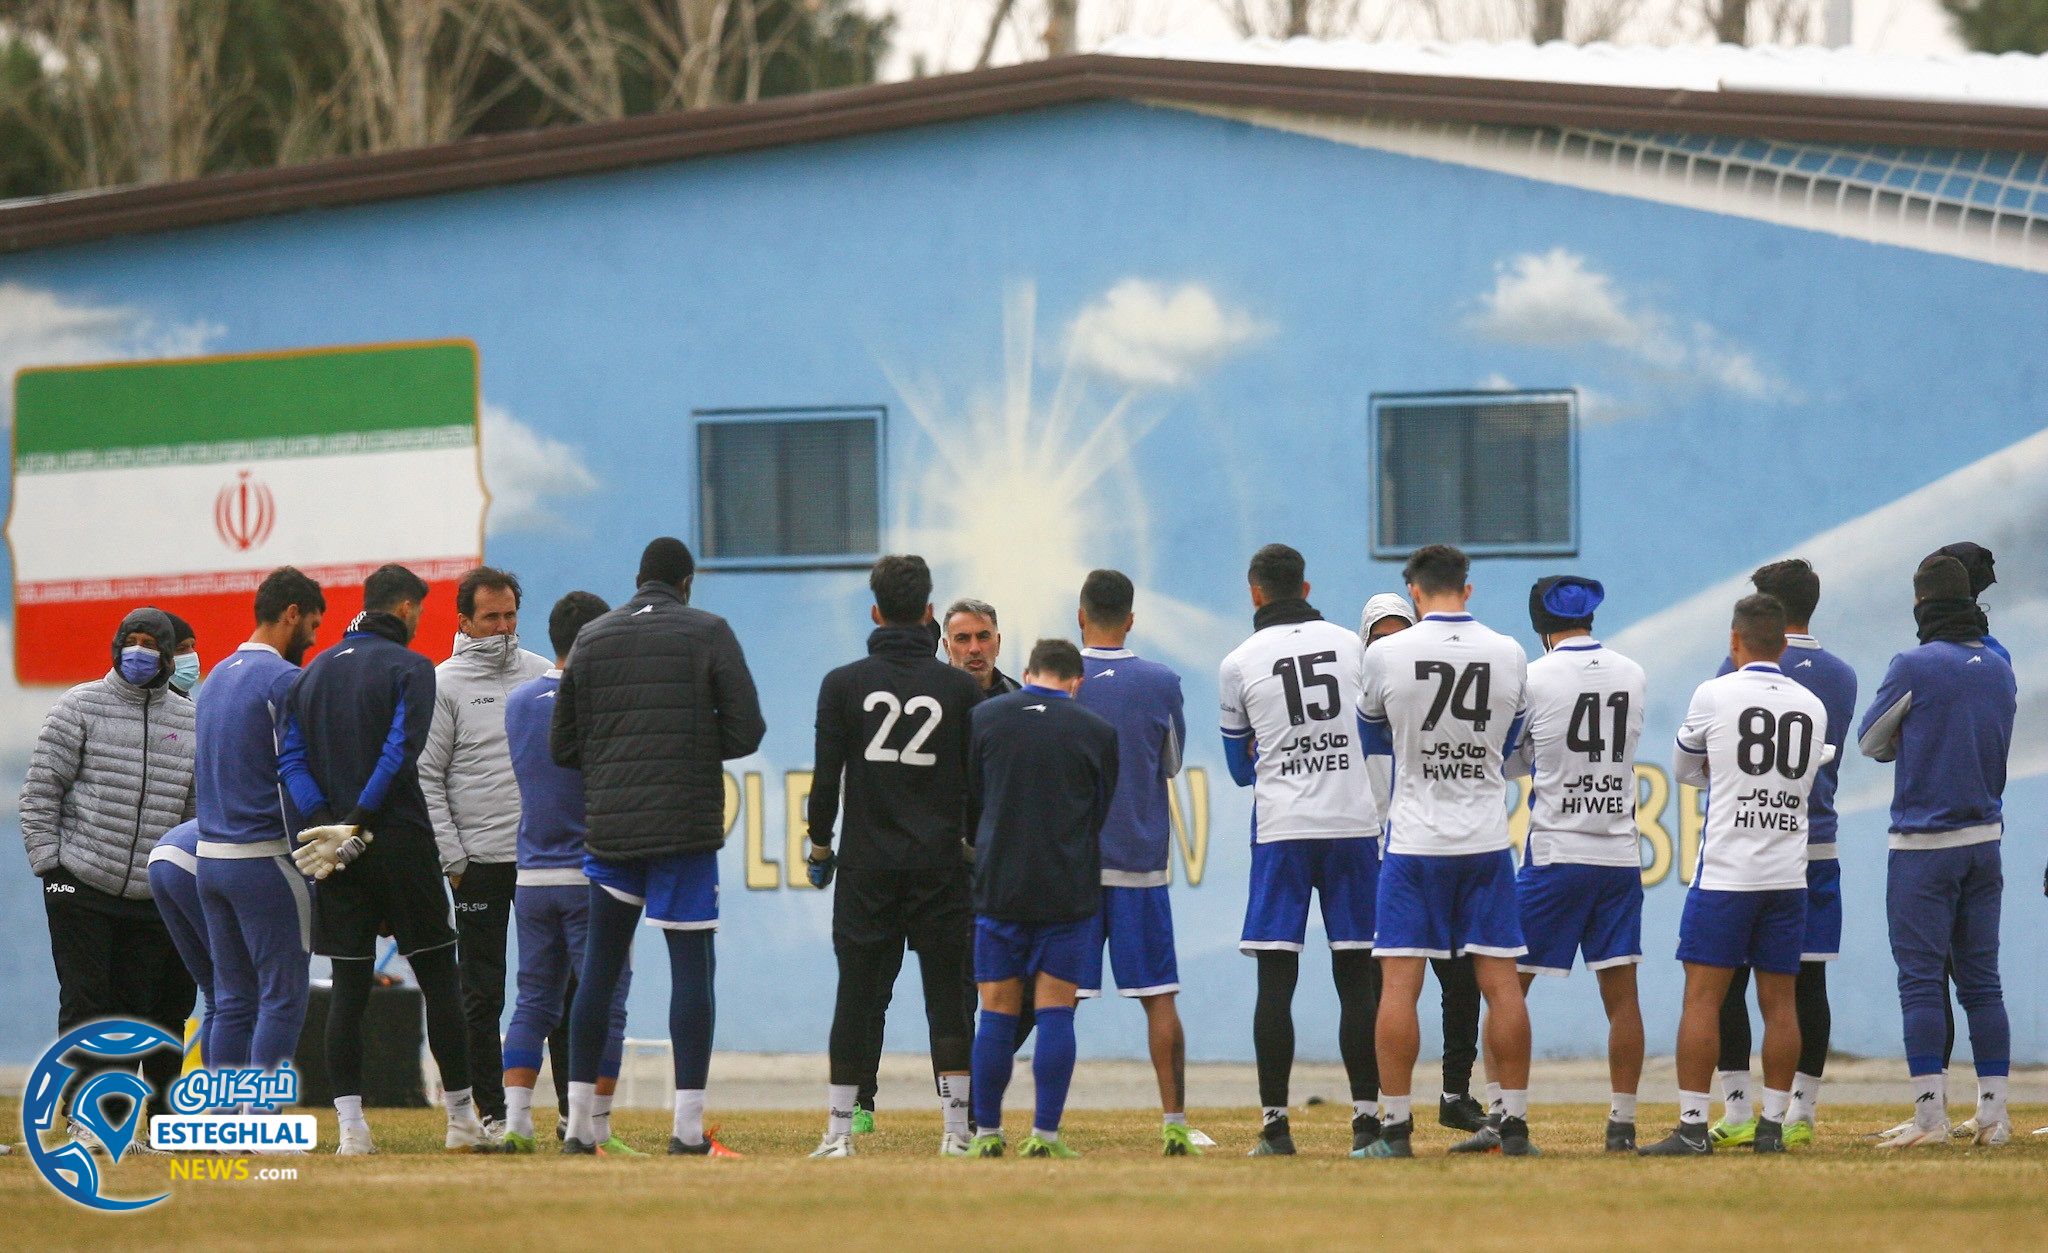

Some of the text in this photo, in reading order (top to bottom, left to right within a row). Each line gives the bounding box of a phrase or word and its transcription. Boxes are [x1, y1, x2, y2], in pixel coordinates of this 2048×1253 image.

[1272, 650, 1341, 726] 15
[1415, 661, 1491, 731] 74
[863, 690, 943, 766] 22
[1567, 691, 1629, 762] 41
[1737, 706, 1813, 780] 80
